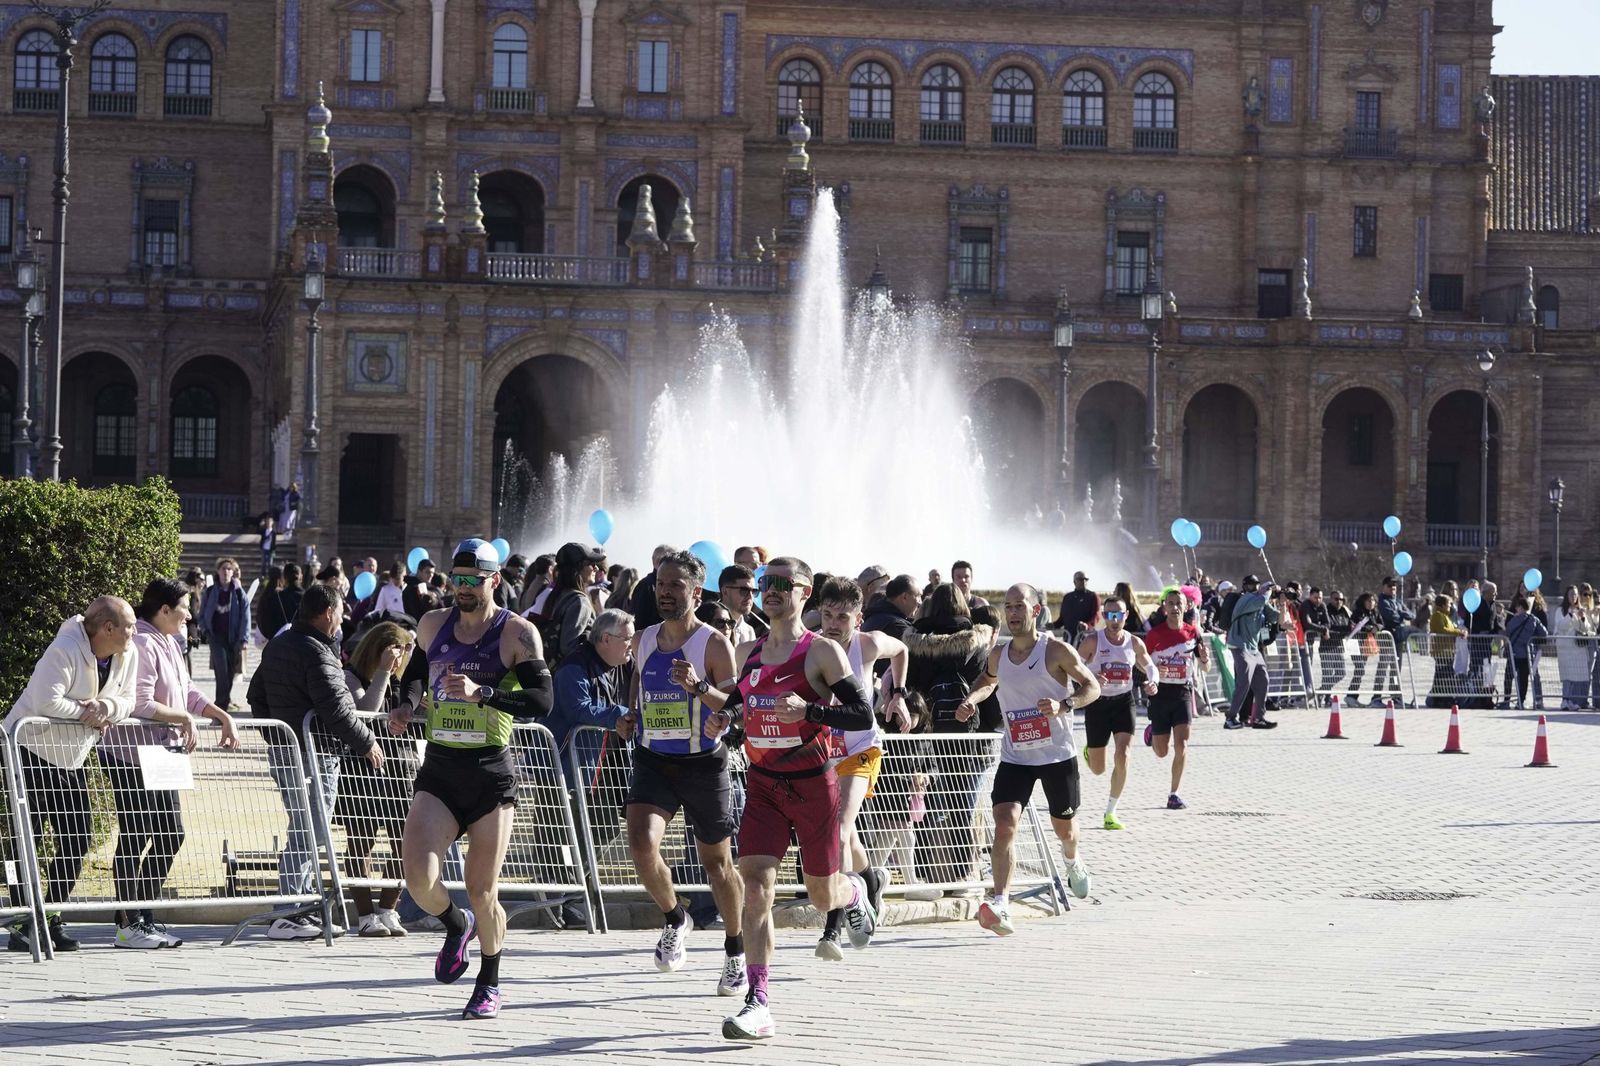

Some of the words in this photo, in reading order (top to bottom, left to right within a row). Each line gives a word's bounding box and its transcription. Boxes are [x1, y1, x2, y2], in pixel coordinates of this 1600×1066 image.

[460, 662, 480, 670] AGEN
[450, 707, 466, 715] 1715
[655, 707, 670, 715] 1672
[1017, 709, 1041, 718] ZURICH
[442, 718, 475, 730] EDWIN
[646, 717, 684, 728] FLORENT
[760, 725, 781, 736] VITI
[1018, 729, 1041, 741] JESÚS
